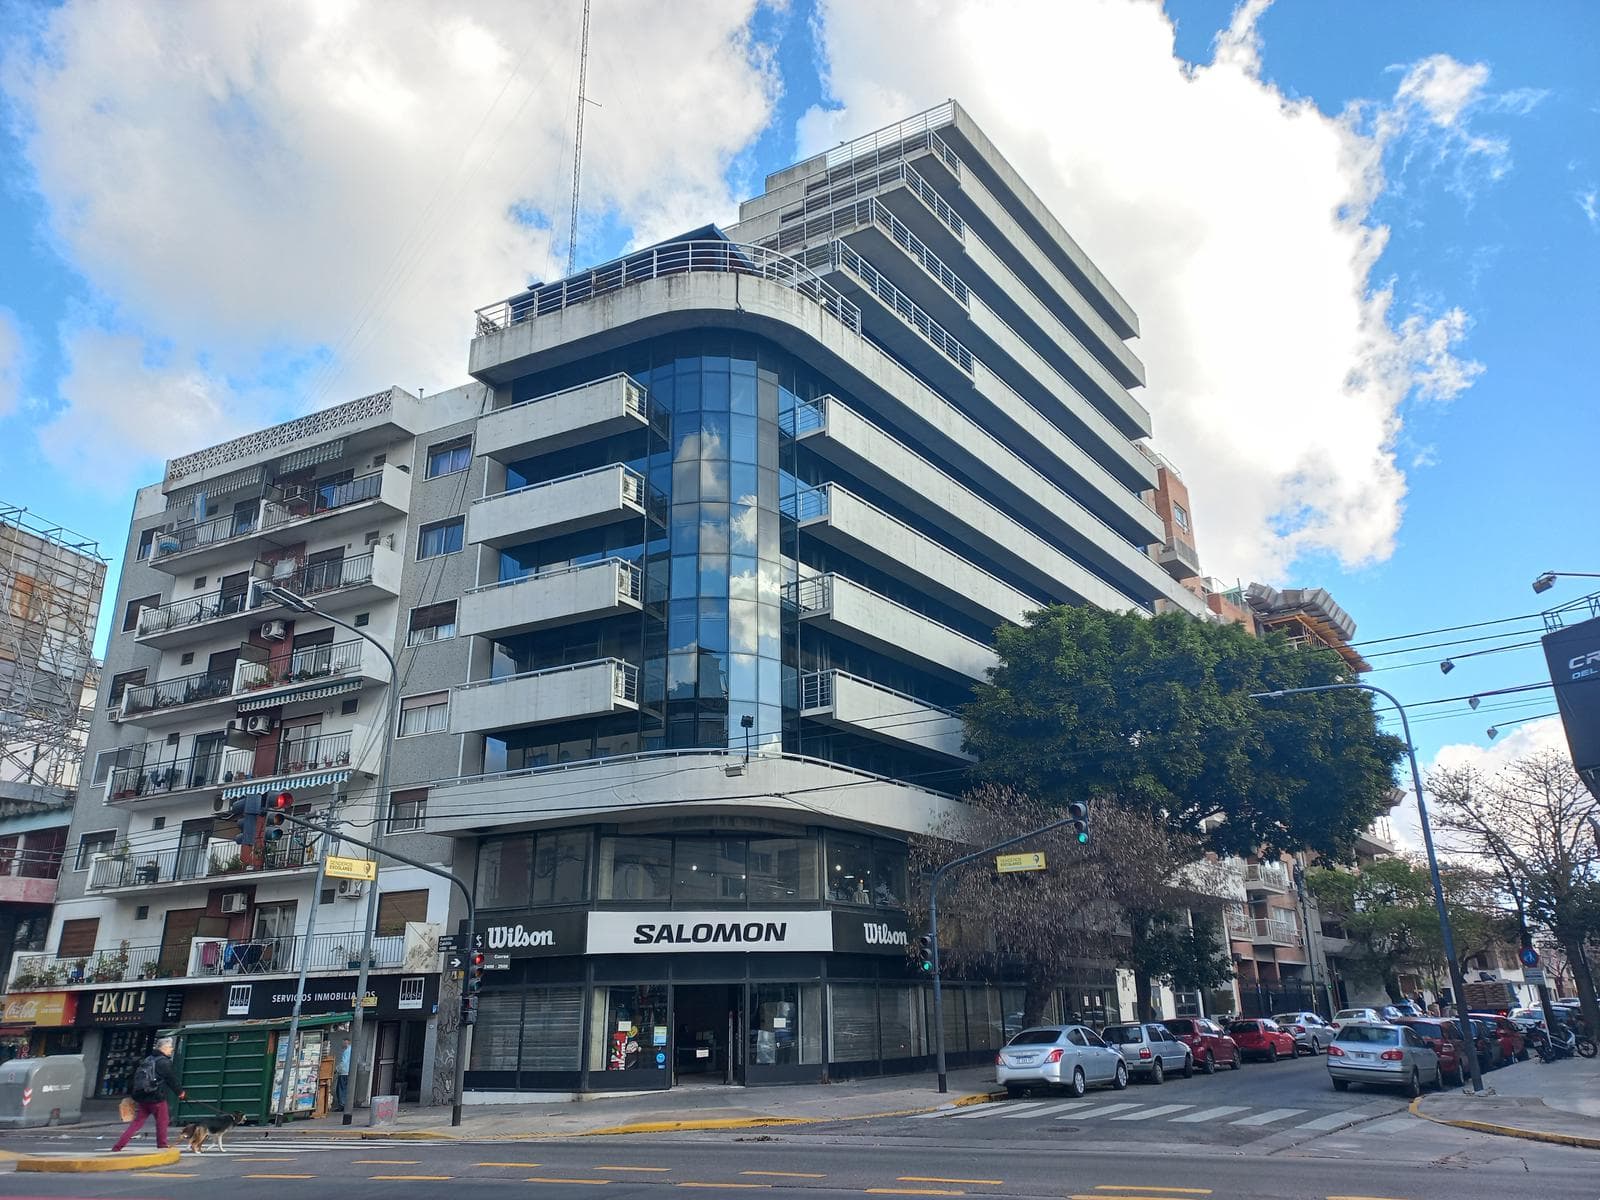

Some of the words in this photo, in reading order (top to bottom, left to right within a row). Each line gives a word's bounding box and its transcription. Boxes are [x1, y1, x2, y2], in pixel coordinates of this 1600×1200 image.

[634, 922, 787, 944] SALOMON
[864, 923, 908, 945] Wilson
[92, 992, 120, 1014] FIX
[271, 992, 312, 1004] SERVICOS
[313, 990, 376, 1002] INMOBILIAOS
